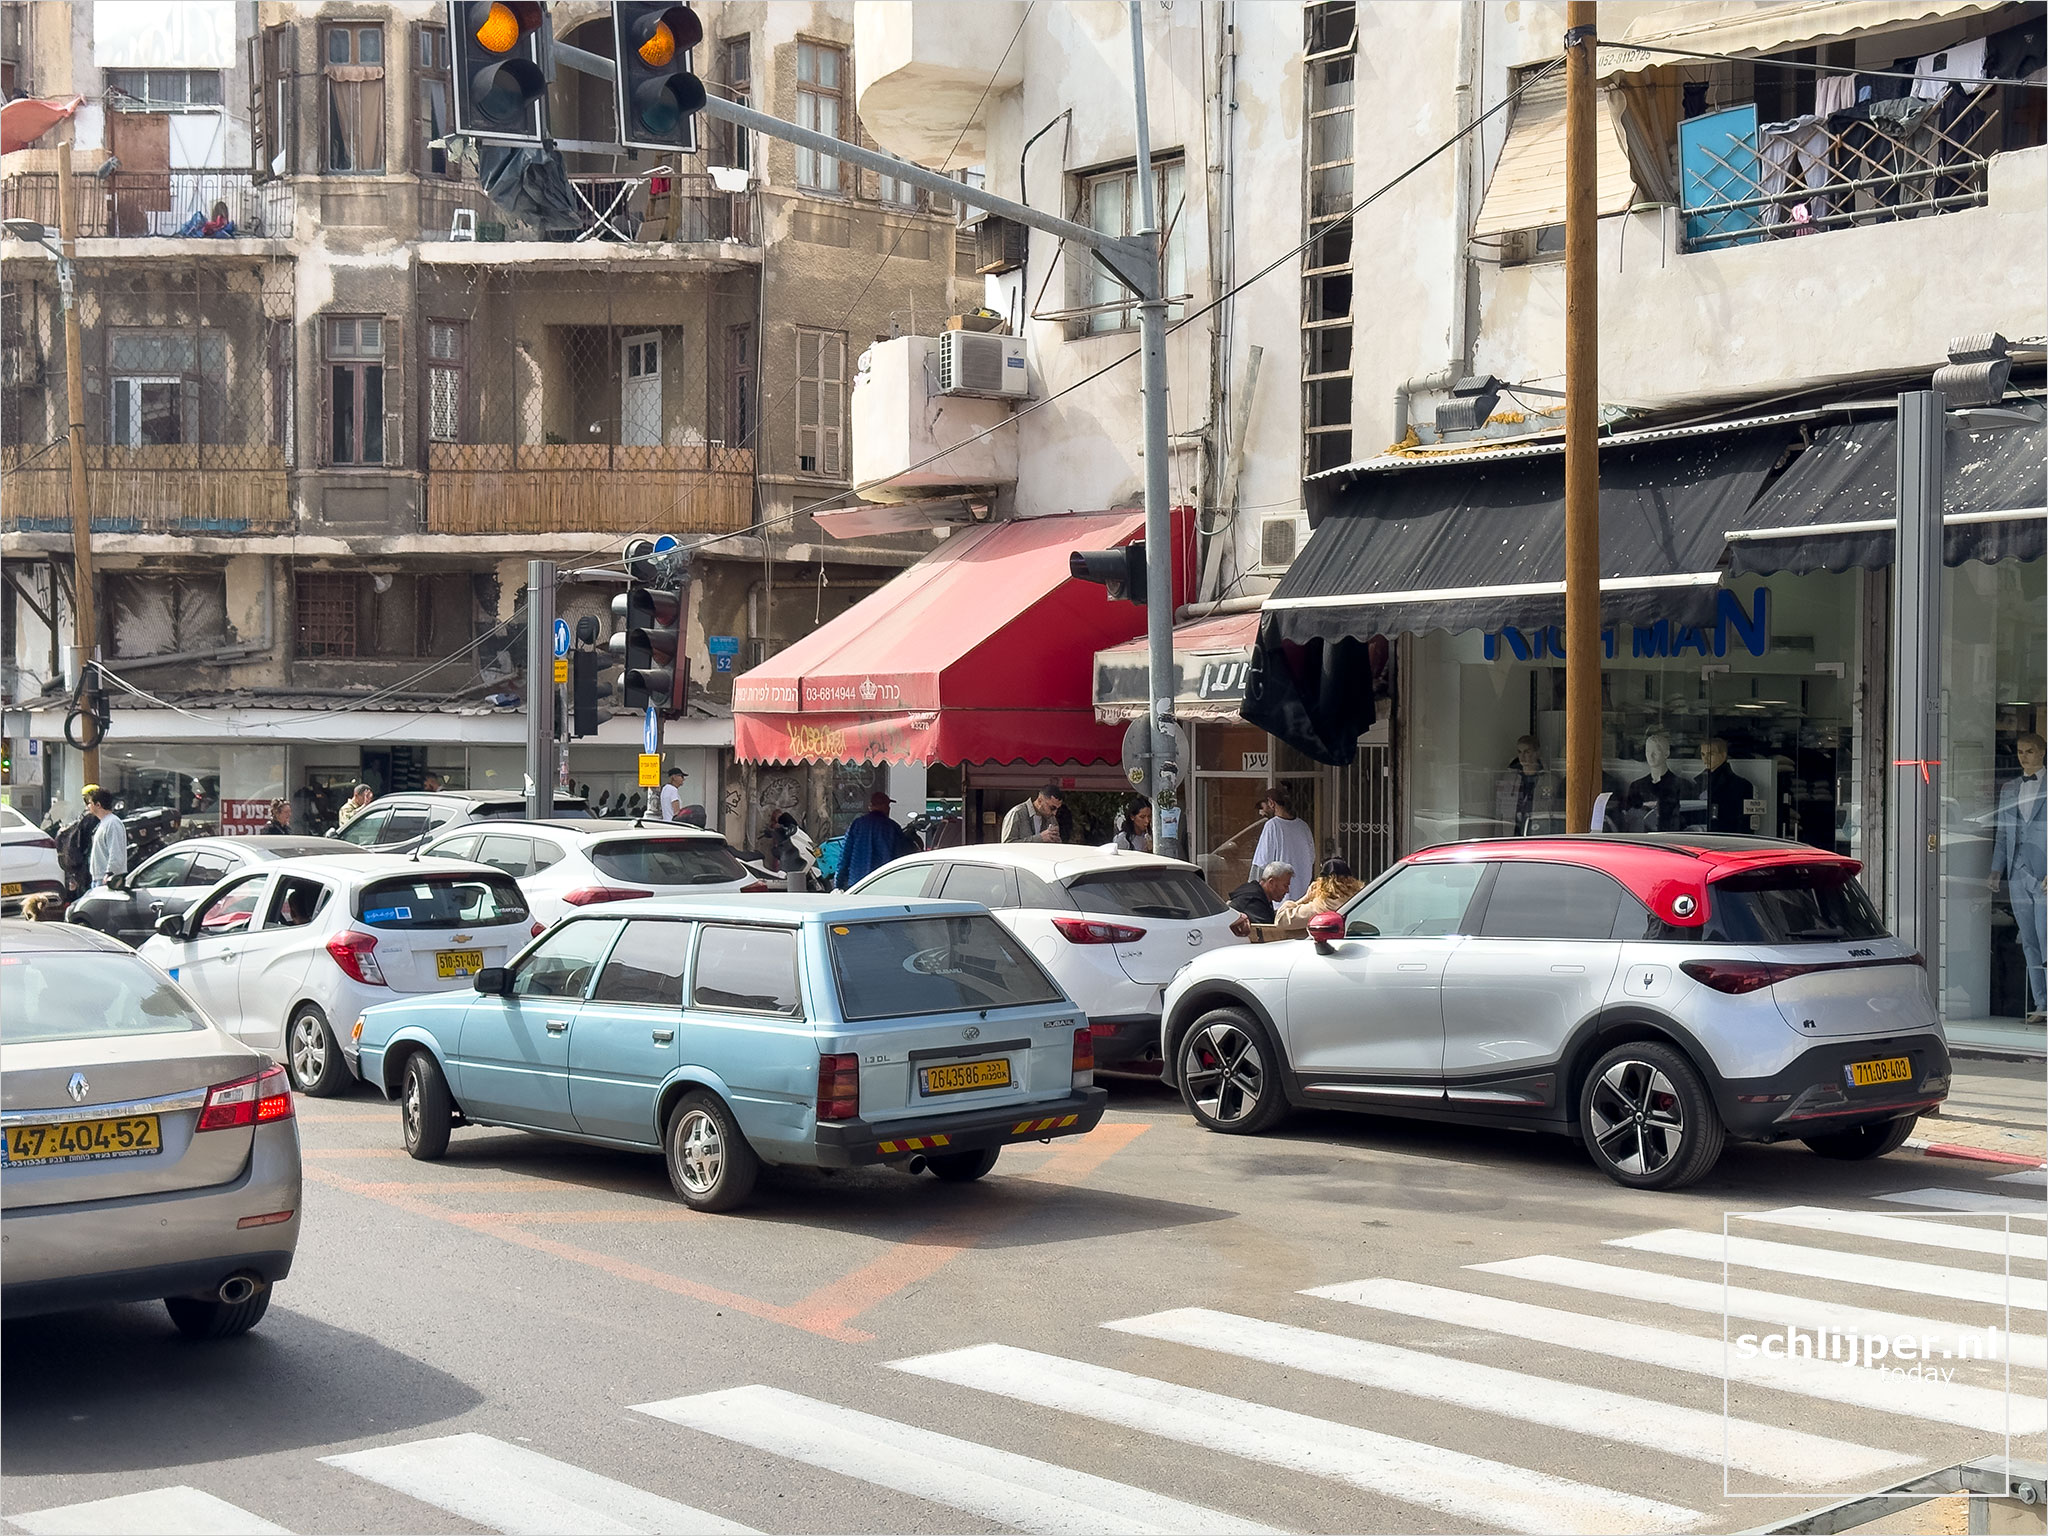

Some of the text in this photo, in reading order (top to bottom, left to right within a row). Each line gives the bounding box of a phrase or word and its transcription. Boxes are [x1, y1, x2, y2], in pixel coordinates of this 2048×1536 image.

[717, 658, 731, 669] 52
[806, 685, 900, 701] 03-6814944 כתר
[1244, 753, 1268, 770] שען
[877, 1055, 890, 1063] DL
[986, 1063, 1001, 1072] רכב
[981, 1071, 1007, 1081] אספנות
